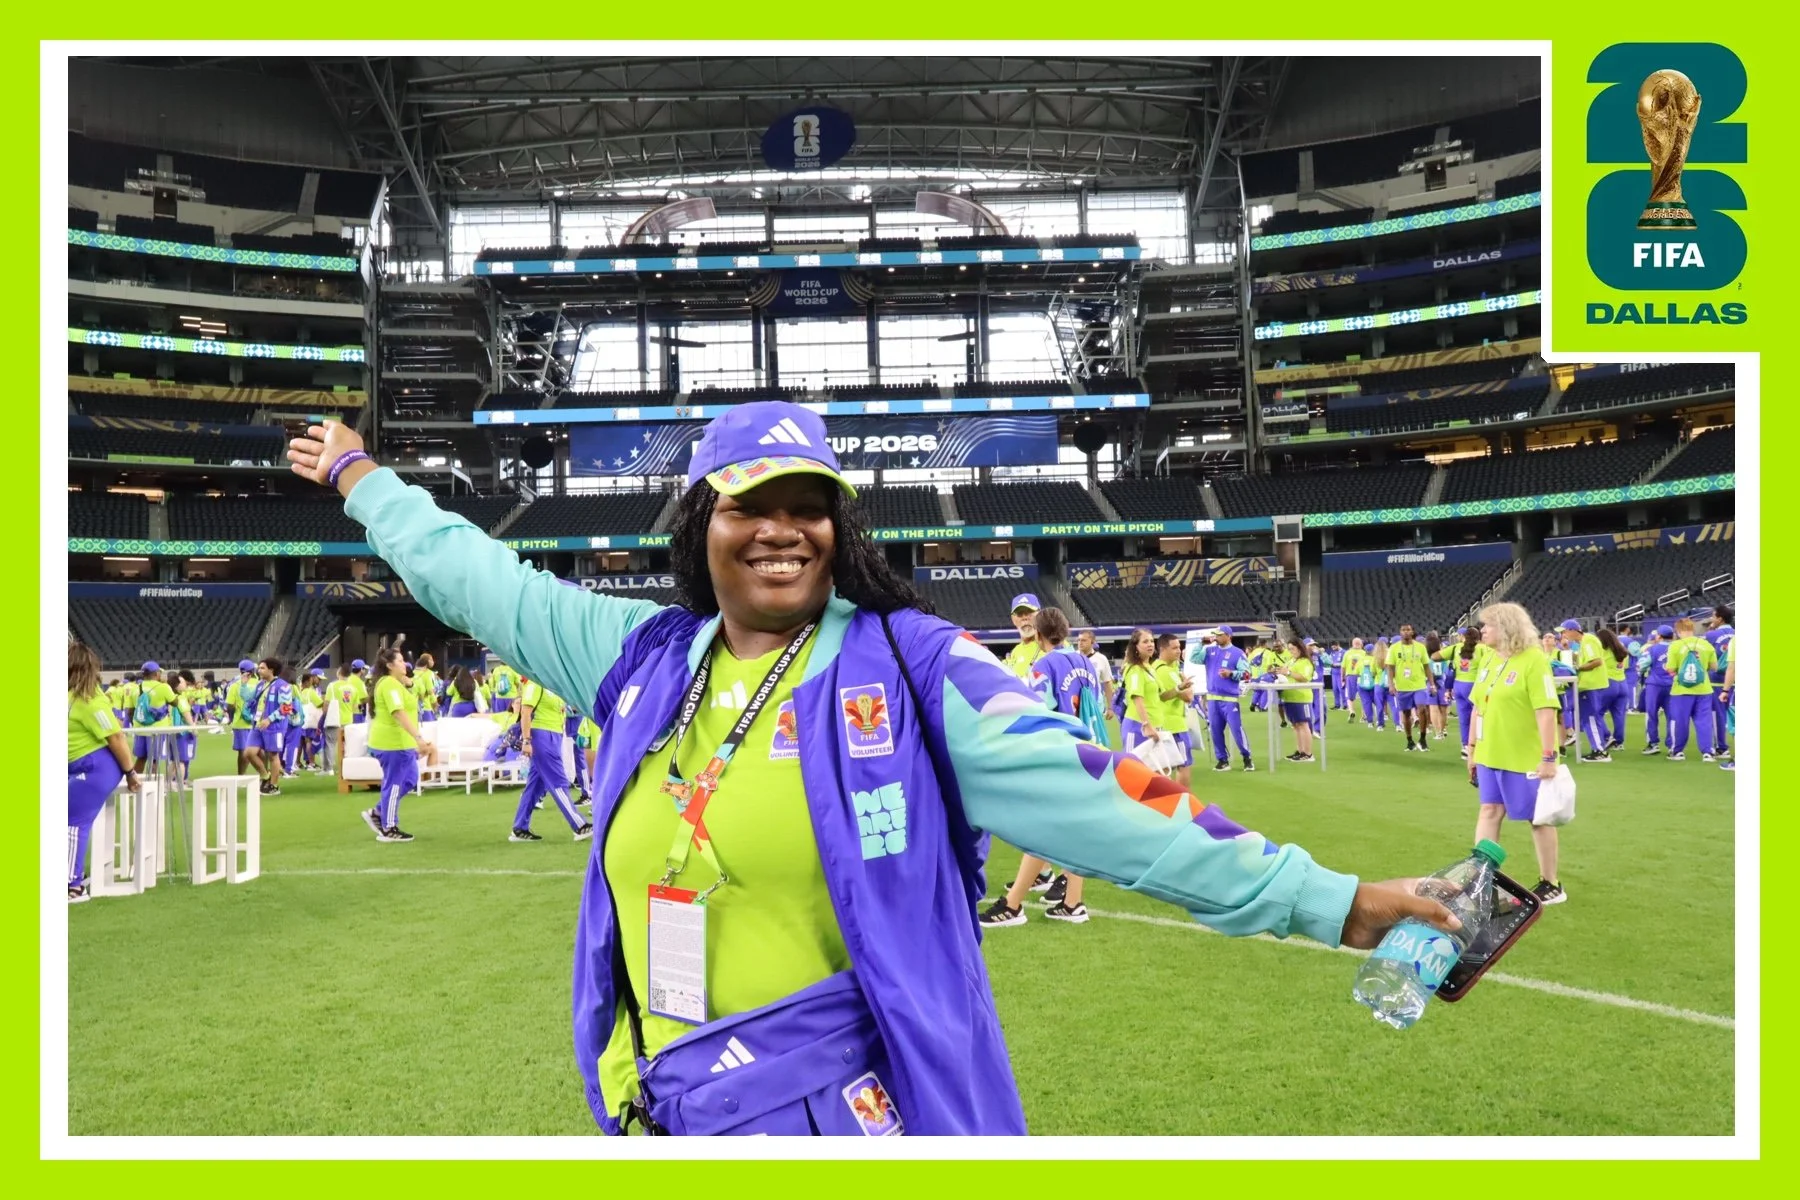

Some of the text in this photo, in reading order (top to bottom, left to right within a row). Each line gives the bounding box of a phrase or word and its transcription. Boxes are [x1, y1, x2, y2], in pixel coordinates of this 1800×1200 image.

[1433, 250, 1502, 269] DALLAS
[800, 280, 821, 288] FIFA
[784, 288, 839, 297] WORLD CUP
[794, 297, 828, 305] 2026
[1620, 362, 1648, 373] FIFA
[825, 434, 938, 454] UP 2026
[882, 530, 899, 539] ON
[901, 529, 924, 538] THE
[927, 528, 963, 537] PITCH
[1042, 523, 1164, 535] PARTY ON THE PITCH
[504, 540, 558, 549] HE PITCH
[638, 536, 672, 546] PART
[1387, 552, 1445, 563] #FIFAWorldCup
[930, 566, 1025, 581] DALLAS
[580, 575, 676, 591] DALLAS
[139, 587, 203, 598] #FIFAWorldCup
[689, 667, 709, 702] WORLD
[735, 623, 815, 735] FIFA WORLD CUP 2026
[683, 702, 696, 724] CUP
[860, 733, 880, 742] FIFA
[851, 746, 893, 757] VOLUNTEER
[1391, 929, 1449, 981] DASANI
